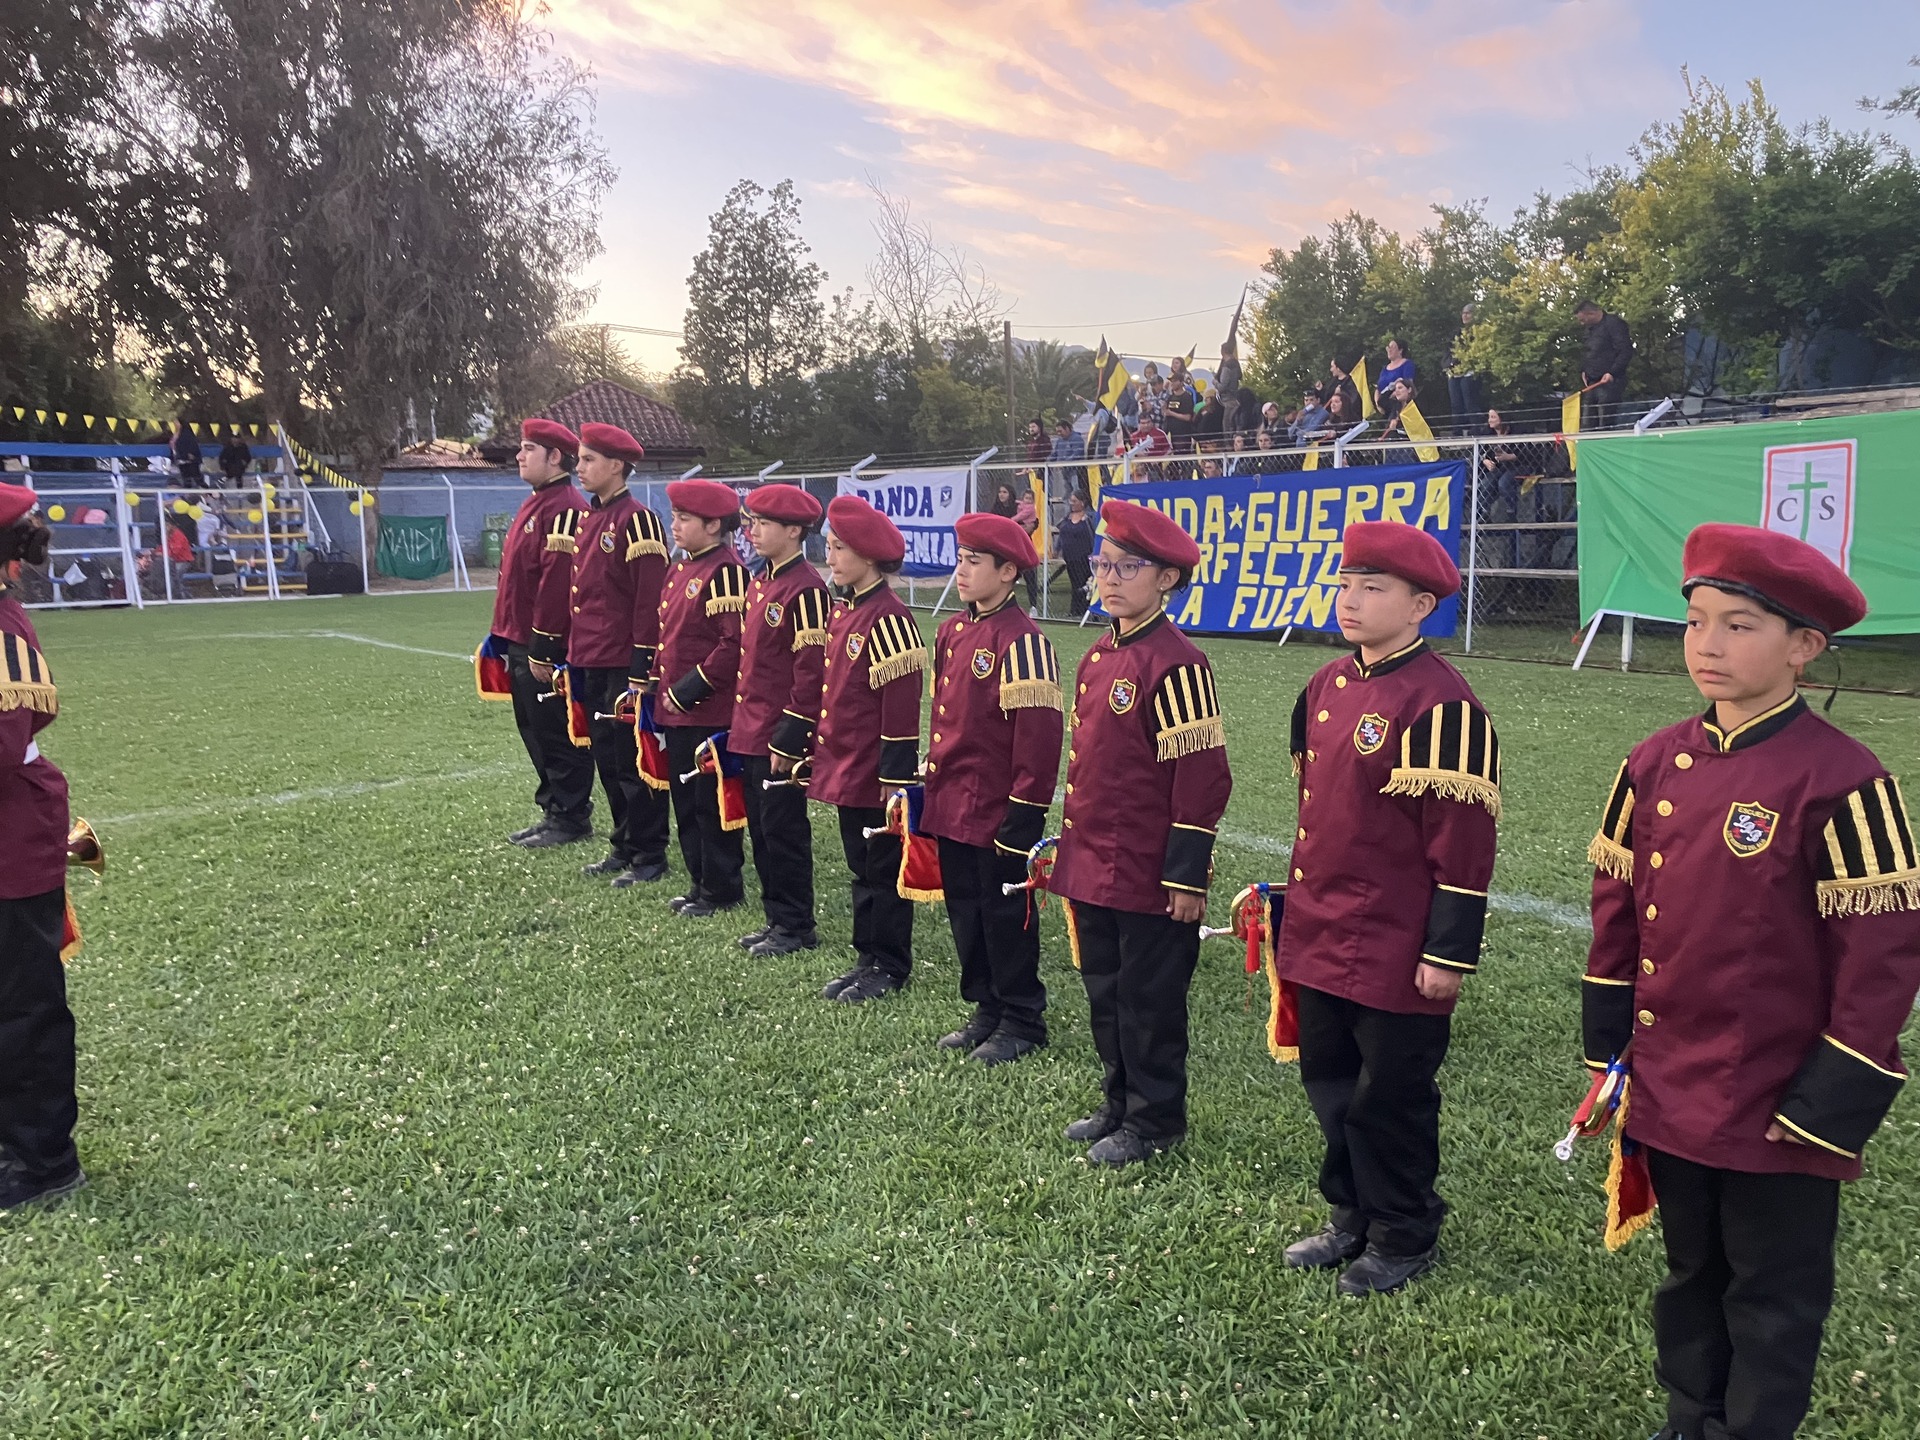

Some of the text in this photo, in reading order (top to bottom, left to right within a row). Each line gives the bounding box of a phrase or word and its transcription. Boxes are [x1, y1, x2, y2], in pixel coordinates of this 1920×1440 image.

[1245, 476, 1452, 542] GUERRA
[1191, 542, 1343, 586] RFECTO
[1228, 584, 1339, 629] FUEN
